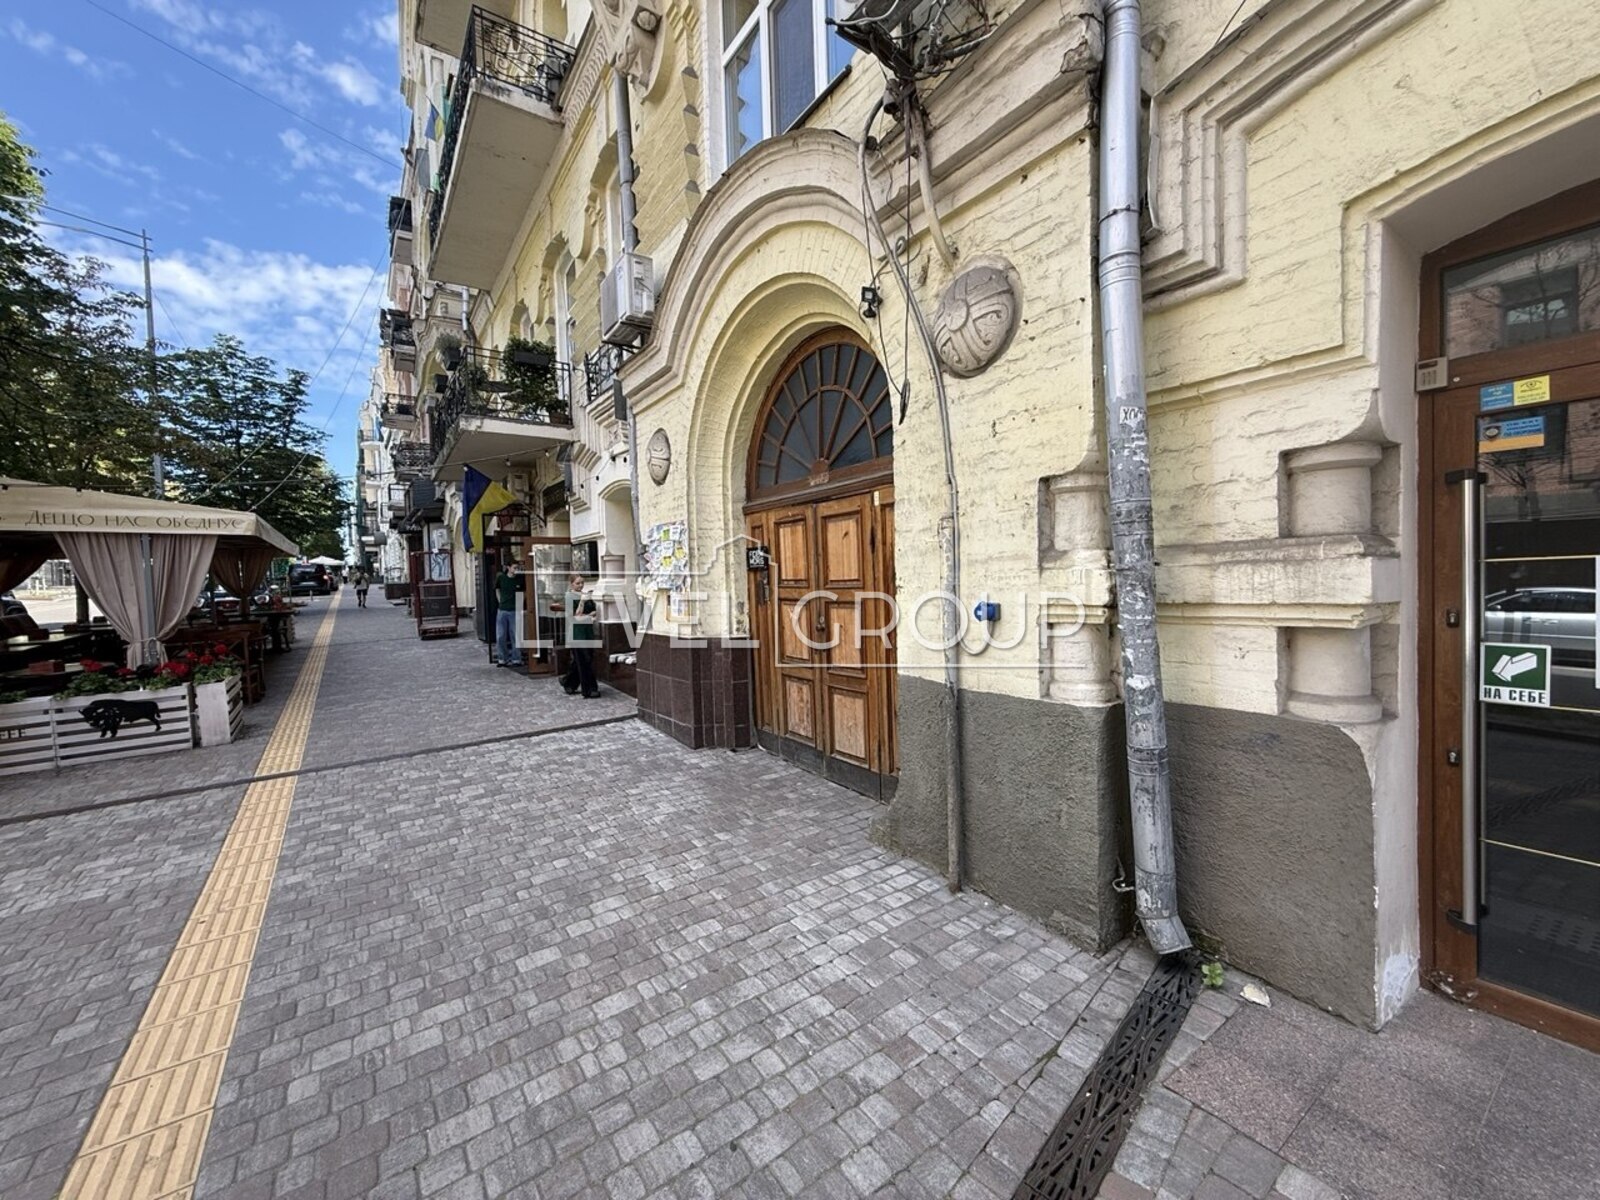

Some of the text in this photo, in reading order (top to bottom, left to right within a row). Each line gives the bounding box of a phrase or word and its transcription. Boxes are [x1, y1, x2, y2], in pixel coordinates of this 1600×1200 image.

[105, 514, 147, 527] НАС
[1483, 687, 1547, 705] НА СЕБЕ
